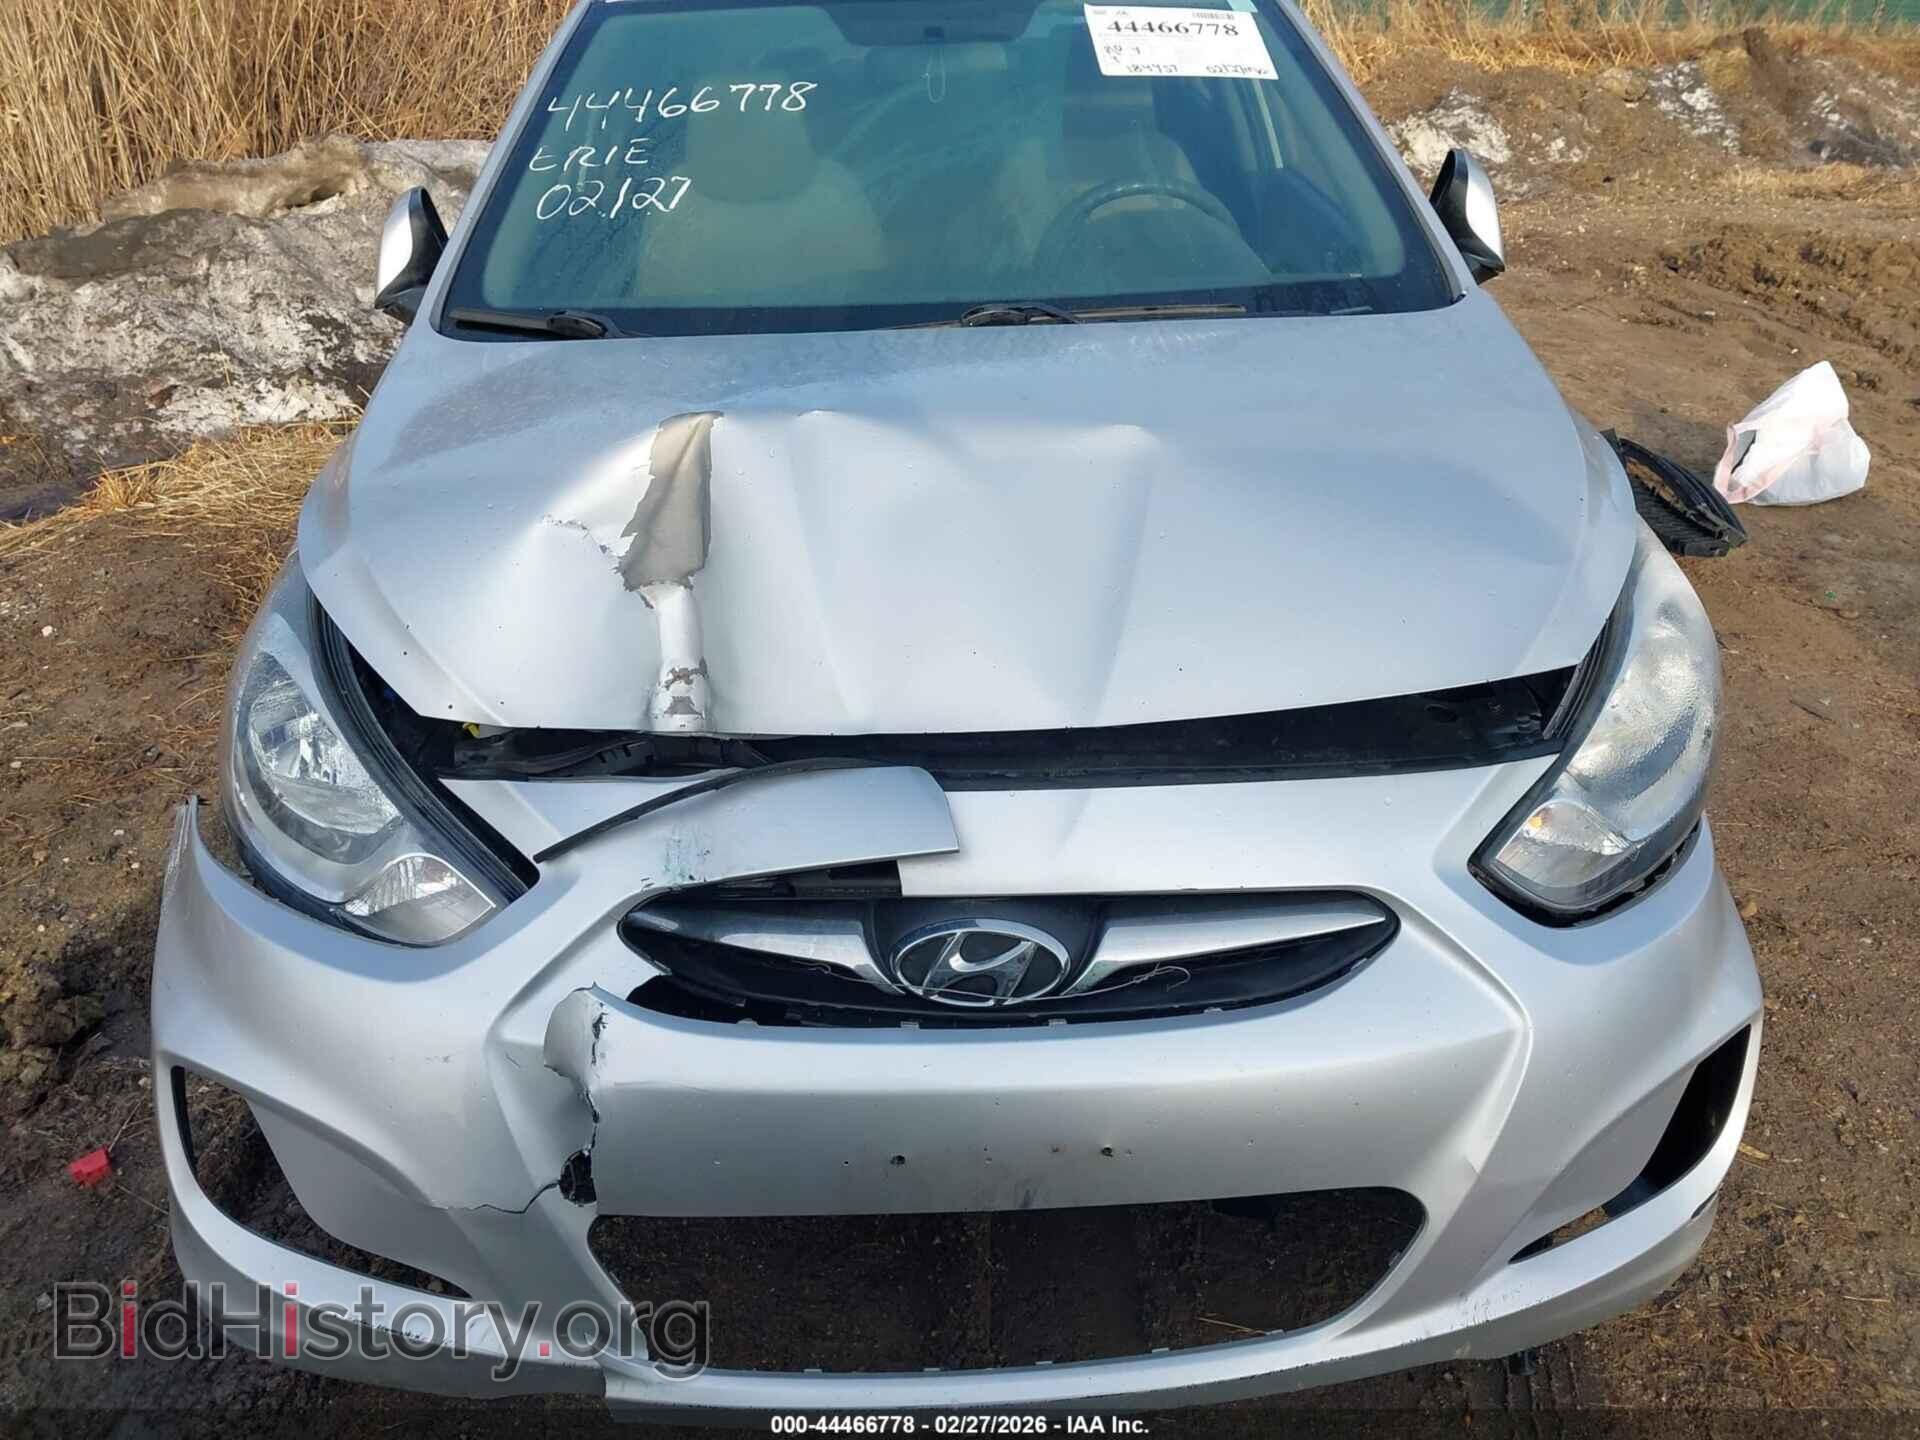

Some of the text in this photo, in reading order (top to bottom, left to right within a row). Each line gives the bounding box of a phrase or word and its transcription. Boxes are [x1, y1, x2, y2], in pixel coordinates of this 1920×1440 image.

[1106, 20, 1240, 37] 44466778
[547, 81, 818, 132] 44466778
[528, 137, 651, 172] ERIE
